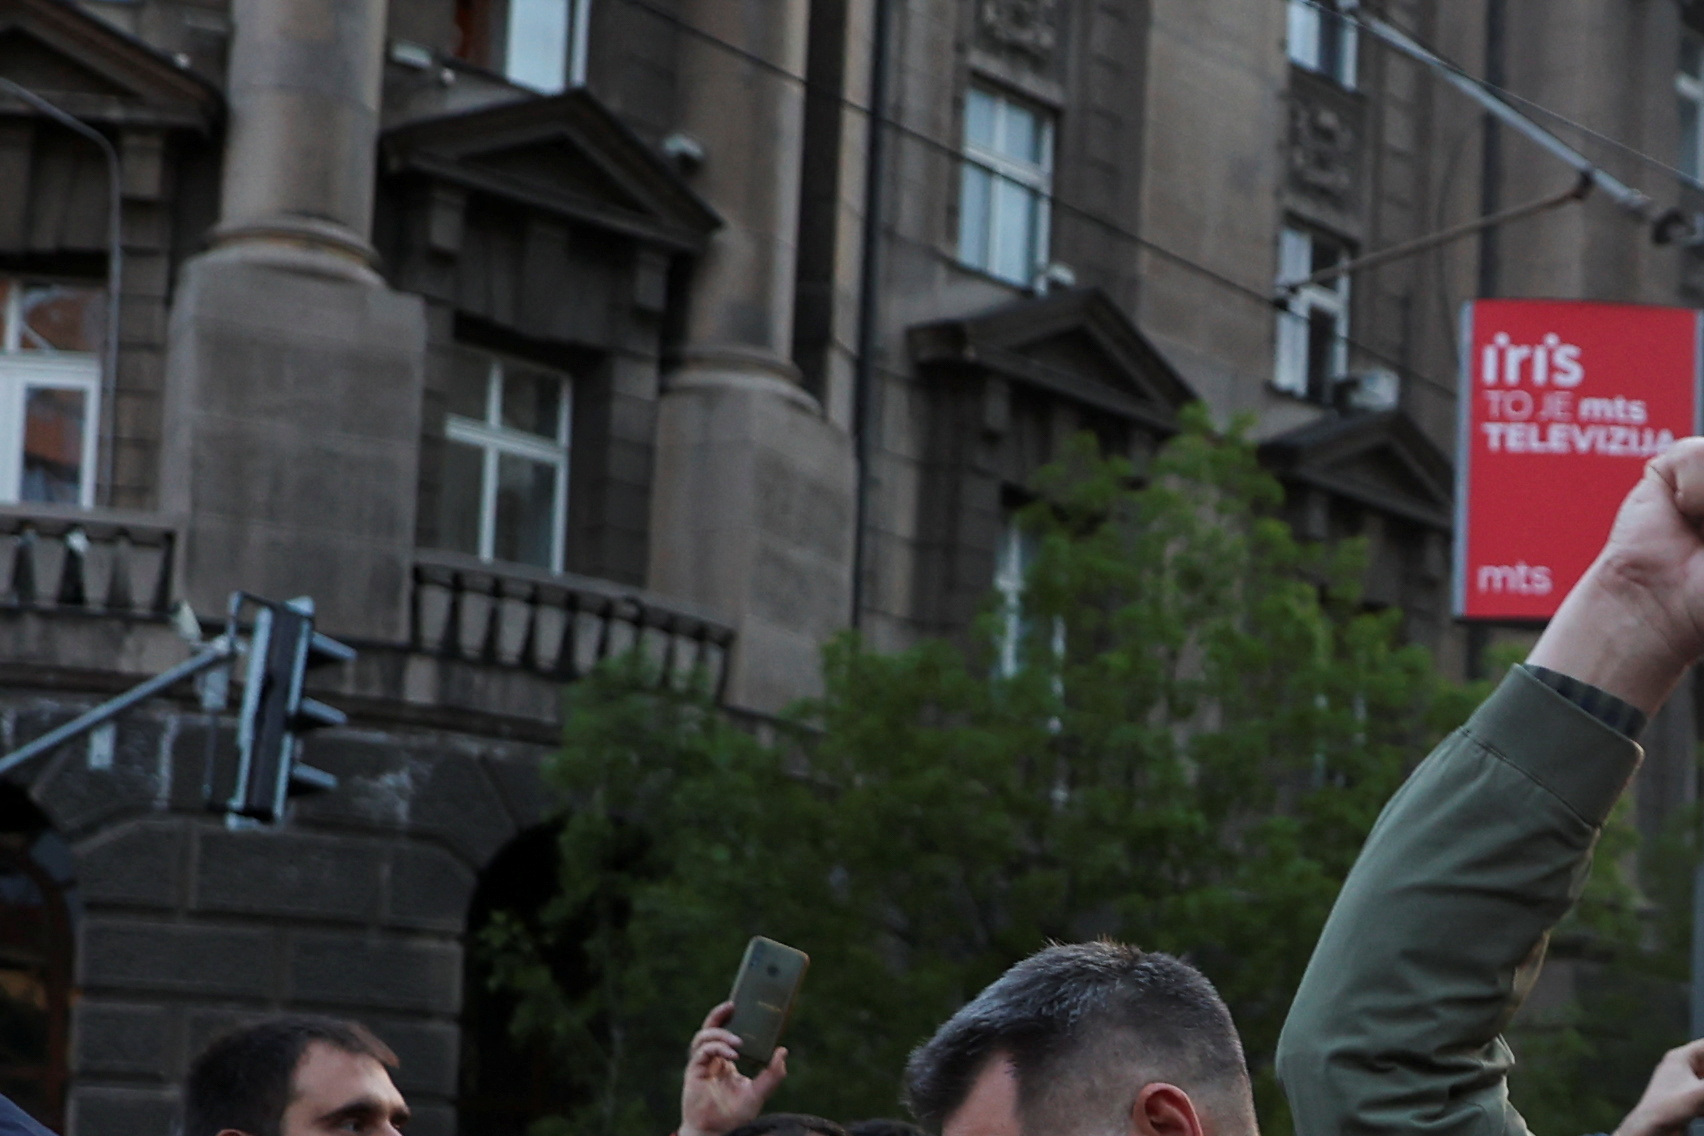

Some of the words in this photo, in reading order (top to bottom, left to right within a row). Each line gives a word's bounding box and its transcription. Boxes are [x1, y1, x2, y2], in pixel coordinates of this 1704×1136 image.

[1482, 332, 1584, 387] iris
[1483, 389, 1534, 421] TO
[1537, 390, 1574, 421] JE
[1577, 395, 1647, 425] mts
[1481, 422, 1678, 457] TELEVIZIJA
[1477, 560, 1552, 595] mts
